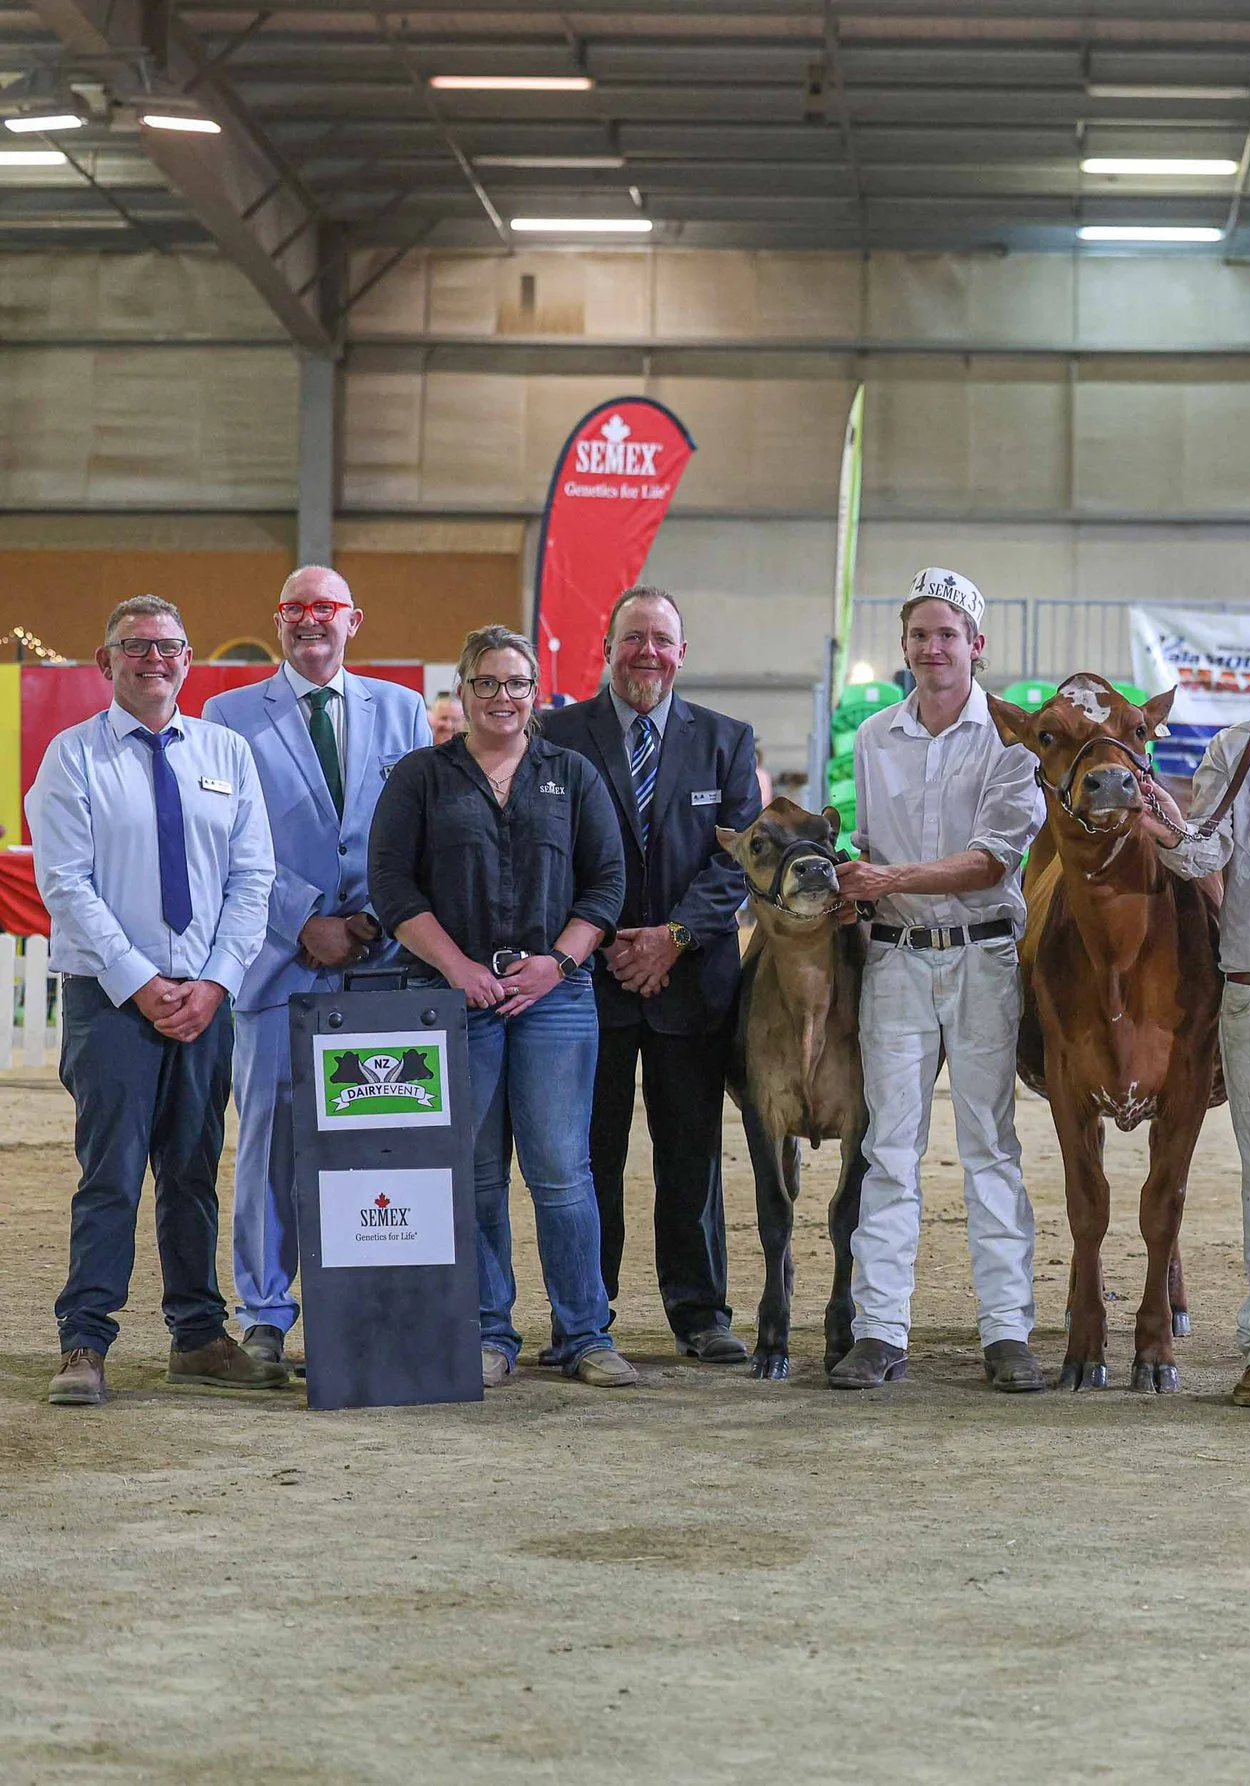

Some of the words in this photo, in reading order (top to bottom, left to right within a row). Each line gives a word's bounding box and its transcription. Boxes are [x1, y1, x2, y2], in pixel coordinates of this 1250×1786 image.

[576, 440, 656, 476] SEMEX
[928, 582, 967, 606] SEMEX
[539, 785, 565, 795] SEMEX
[374, 1059, 390, 1069] NZ
[347, 1085, 420, 1099] DAIRYEVENT
[360, 1208, 409, 1227] SEMEX
[355, 1233, 387, 1242] Genetics
[388, 1232, 399, 1241] for
[401, 1231, 415, 1240] Life
